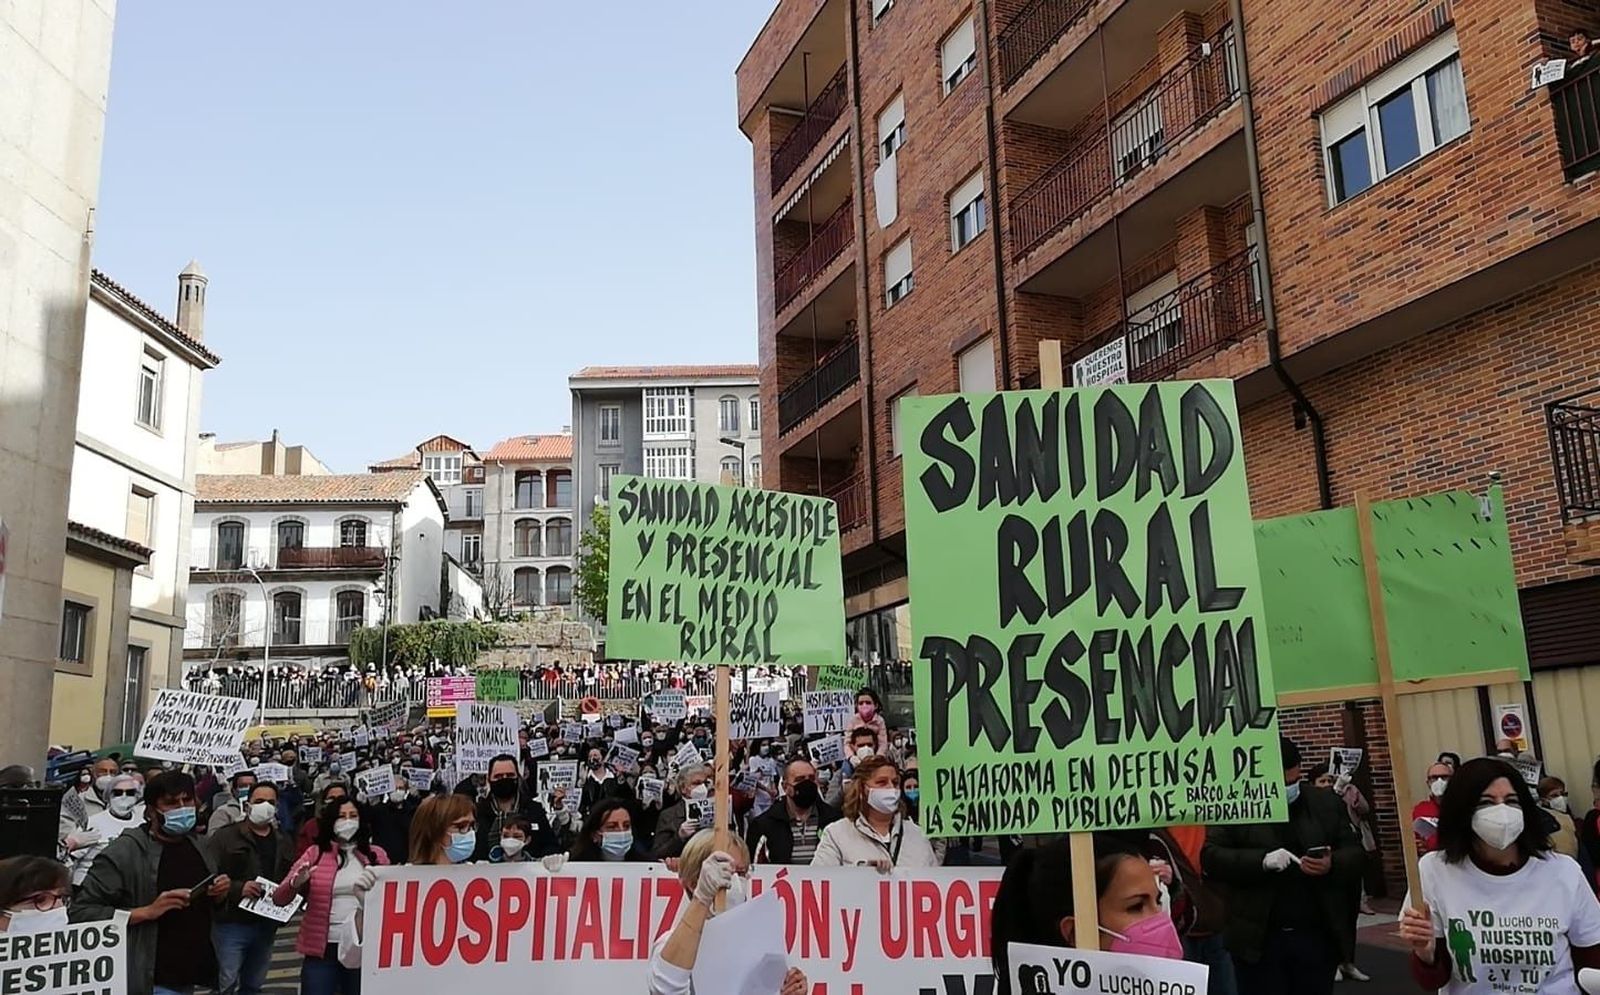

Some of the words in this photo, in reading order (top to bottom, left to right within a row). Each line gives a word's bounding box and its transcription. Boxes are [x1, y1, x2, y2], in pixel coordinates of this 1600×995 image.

[1085, 339, 1123, 366] QUEREMOS
[1086, 350, 1122, 376] NUESTRO
[1086, 361, 1124, 387] HOSPITAL
[920, 383, 1234, 513] SANIDAD
[618, 477, 720, 533] SANIDAD
[726, 489, 836, 546] ACCESIBLE
[635, 529, 656, 571] Y
[665, 531, 823, 590] PRESENCIAL
[997, 499, 1246, 629] RURAL
[621, 576, 652, 623] EN
[659, 583, 686, 624] EL
[698, 582, 779, 628] MEDIO
[680, 621, 782, 663] RURAL
[919, 617, 1276, 756] PRESENCIAL
[157, 691, 242, 716] DESMANTELAN
[471, 705, 504, 725] HOSPITAL
[730, 706, 779, 724] COMARCAL
[151, 709, 198, 728] HOSPITAL
[142, 742, 151, 750] NO
[144, 724, 157, 741] EN
[159, 727, 184, 745] PLENA
[187, 730, 234, 748] PANDEMIA
[458, 726, 515, 747] PLURICOMARCAL
[936, 758, 1056, 802] PLATAFORMA
[1069, 756, 1096, 793] EN
[1108, 747, 1217, 790] DEFENSA
[1232, 745, 1265, 782] DE
[1186, 784, 1223, 803] BARCO
[925, 802, 944, 835] LA
[952, 799, 1040, 831] SANIDAD
[1052, 791, 1140, 830] PÚBLICA
[1151, 790, 1177, 824] DE
[1194, 800, 1272, 822] PIEDRAHITA
[1467, 910, 1495, 928] YO
[1499, 917, 1533, 929] LUCHO
[1538, 917, 1559, 929] POR
[840, 908, 861, 972] y
[1481, 930, 1554, 947] NUESTRO
[1480, 949, 1556, 966] HOSPITAL
[2, 955, 114, 995] ESTRO
[1052, 957, 1092, 989] YO
[1099, 973, 1155, 995] LUCHO
